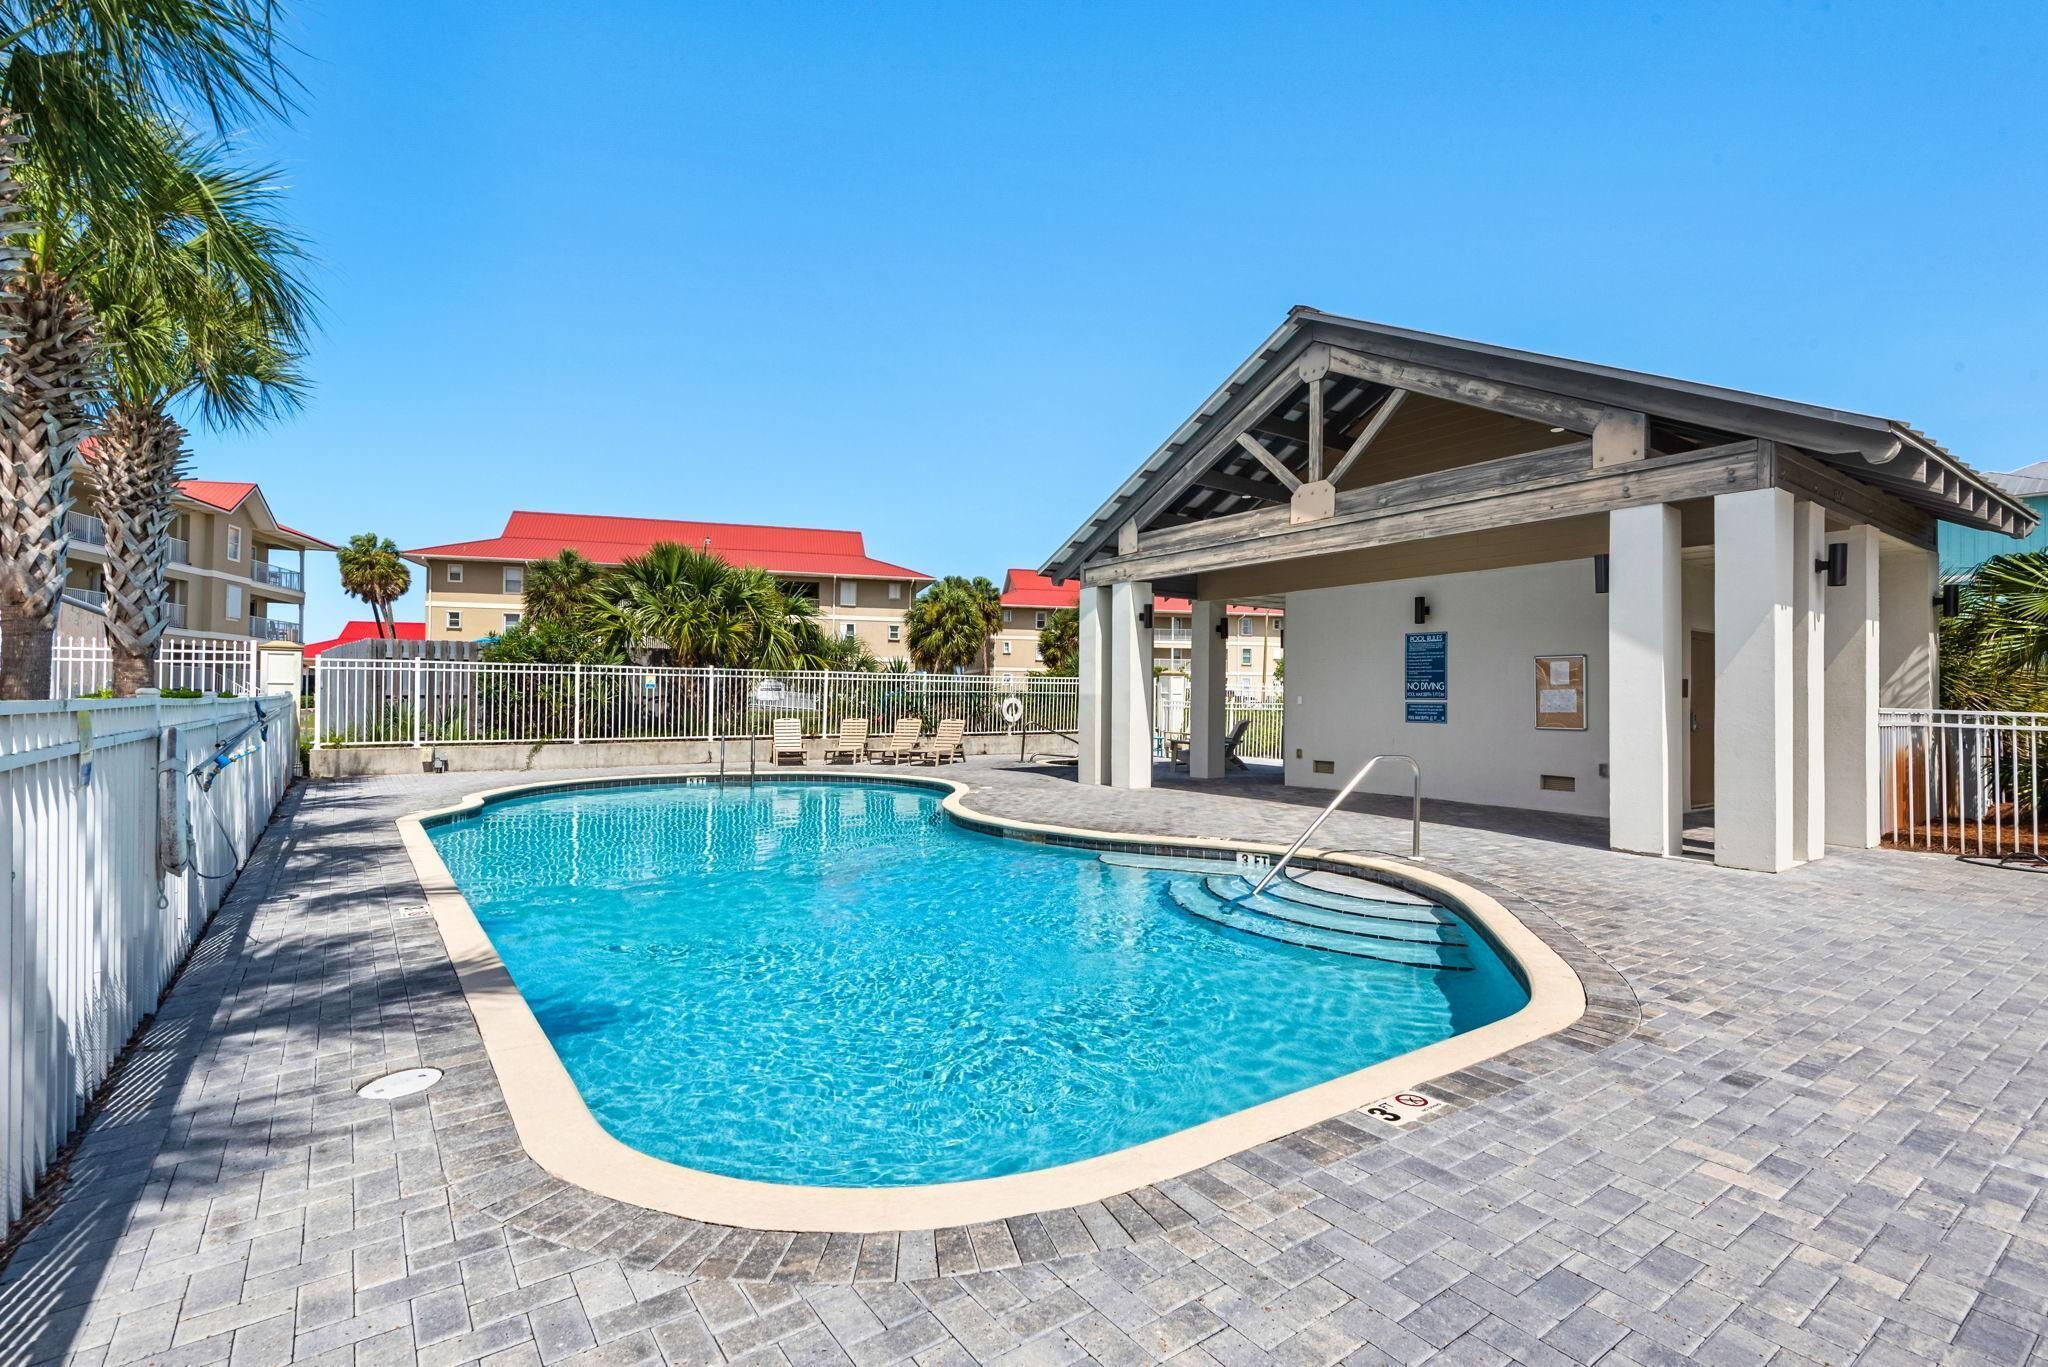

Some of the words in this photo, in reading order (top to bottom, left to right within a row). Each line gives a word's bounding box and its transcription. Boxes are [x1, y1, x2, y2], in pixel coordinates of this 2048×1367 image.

[1407, 682, 1419, 690] NO
[1420, 682, 1445, 690] DIVING
[1254, 855, 1268, 865] FT
[1367, 1107, 1401, 1122] 3
